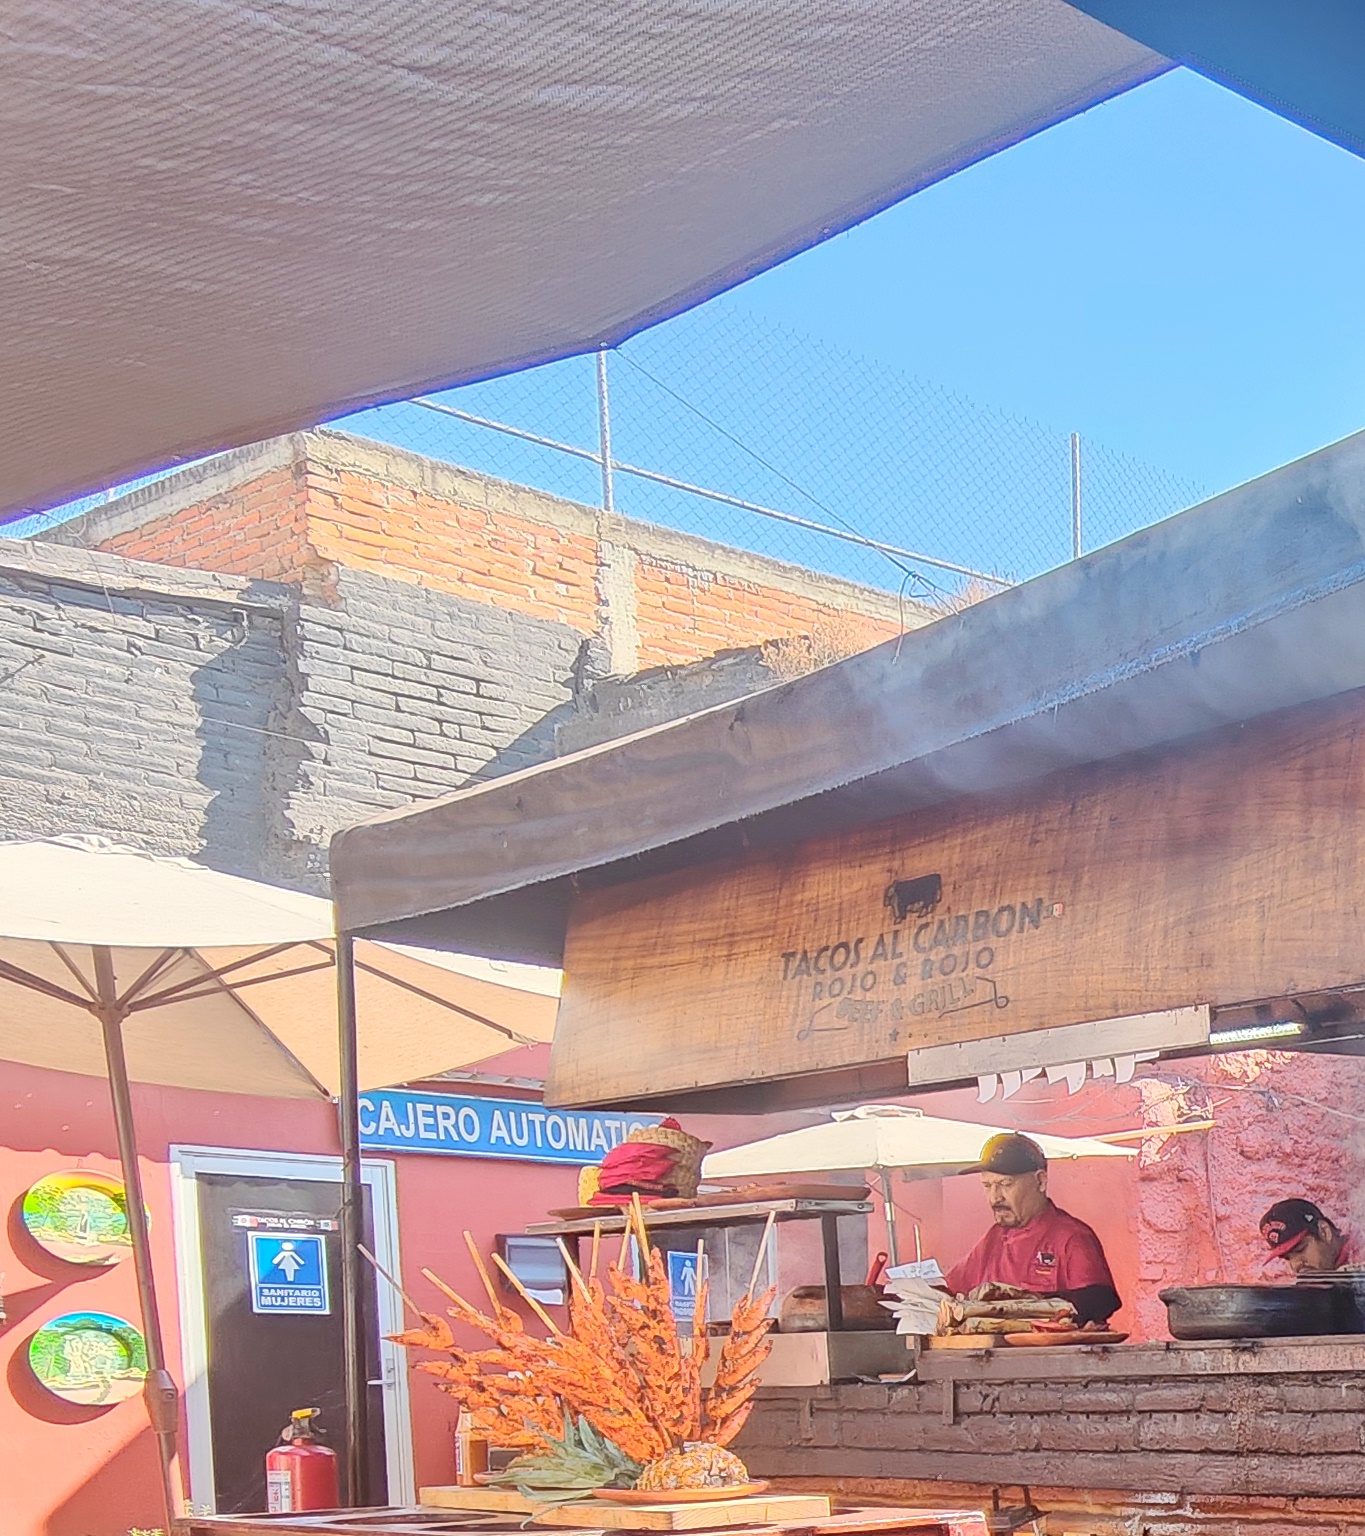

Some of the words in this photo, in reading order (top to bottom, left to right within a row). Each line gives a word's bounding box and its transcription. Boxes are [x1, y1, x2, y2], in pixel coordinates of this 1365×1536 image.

[781, 938, 864, 980] TACOS
[869, 930, 904, 964] AL
[913, 898, 1043, 953] CARBON
[812, 971, 877, 1002] ROJO
[893, 963, 907, 986] &
[921, 947, 995, 979] ROJO
[909, 977, 975, 1015] GRILL
[359, 1097, 480, 1142] CAJERO
[490, 1110, 659, 1153] AUTOMATI
[261, 1297, 321, 1306] MUJERES
[262, 1289, 320, 1297] SANITARIO
